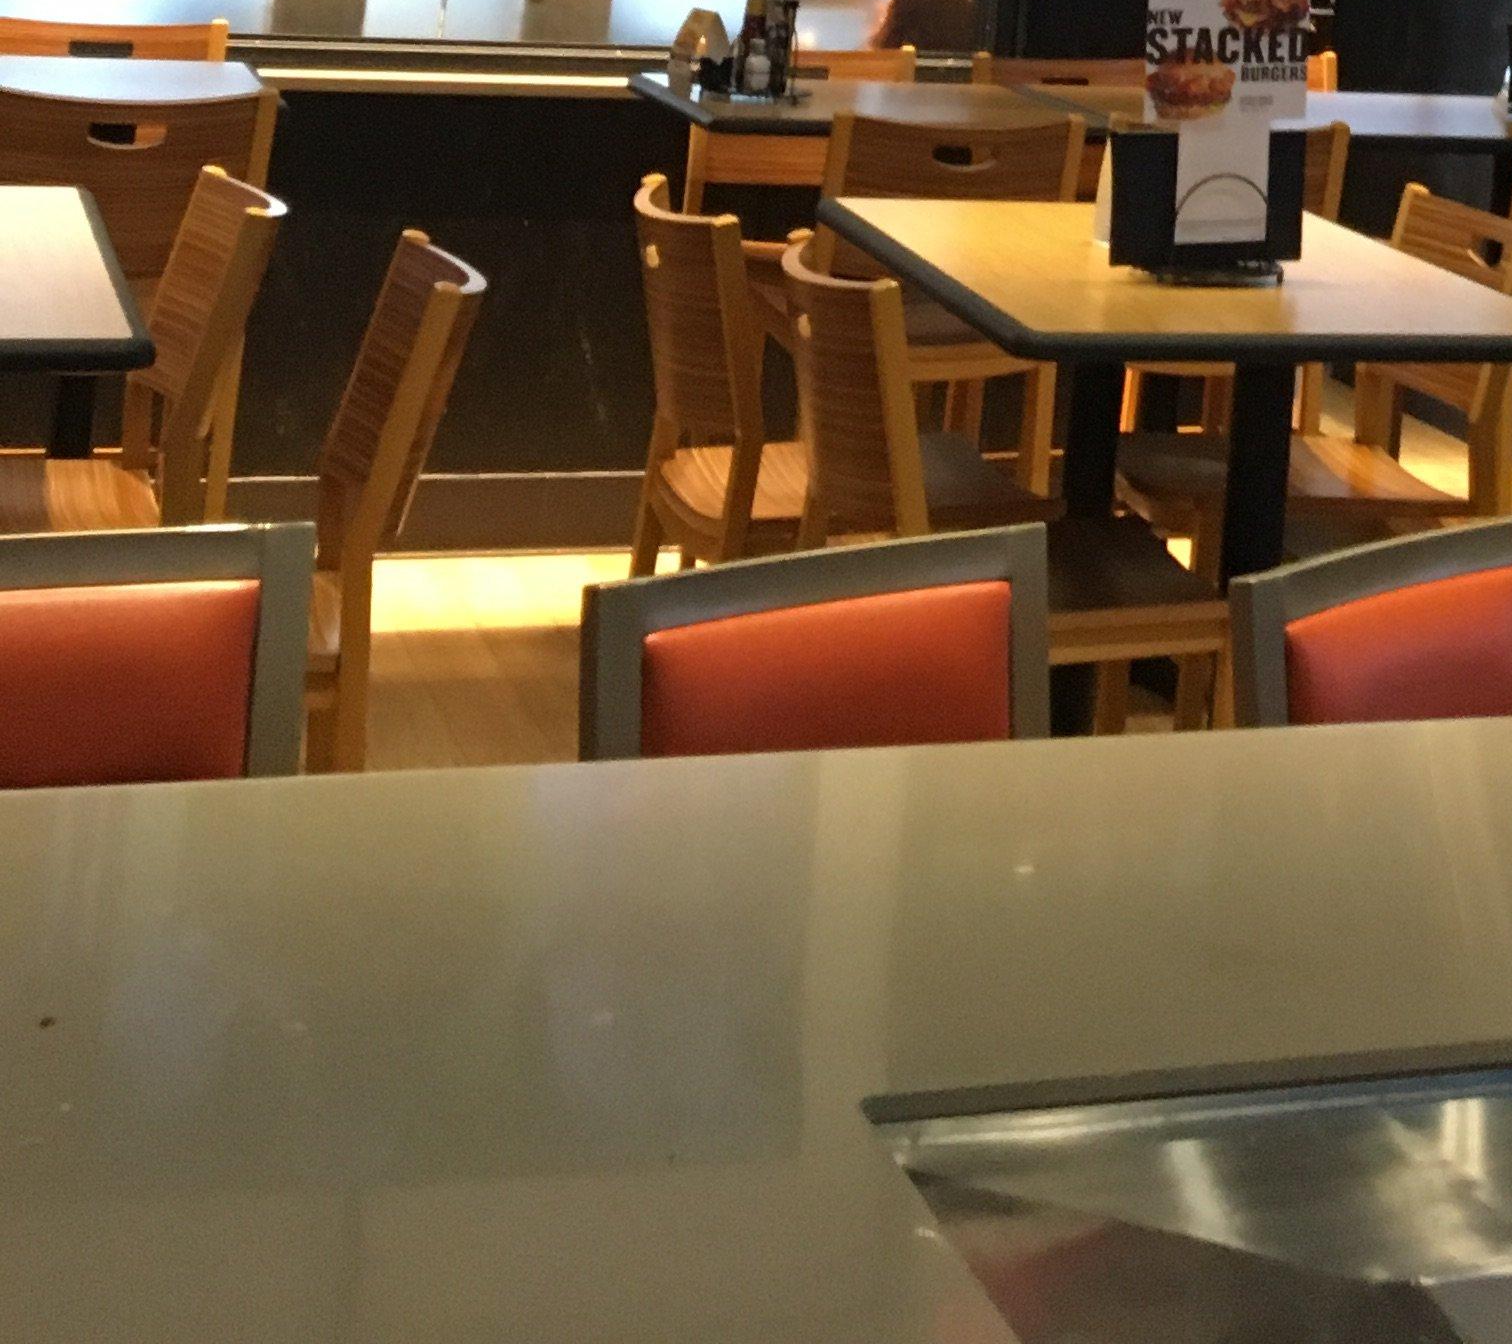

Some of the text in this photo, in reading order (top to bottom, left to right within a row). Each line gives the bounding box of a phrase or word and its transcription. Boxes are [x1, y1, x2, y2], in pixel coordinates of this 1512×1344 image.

[1149, 9, 1183, 25] NEW
[1146, 26, 1307, 65] STACKED
[1240, 63, 1307, 83] BURGERS
